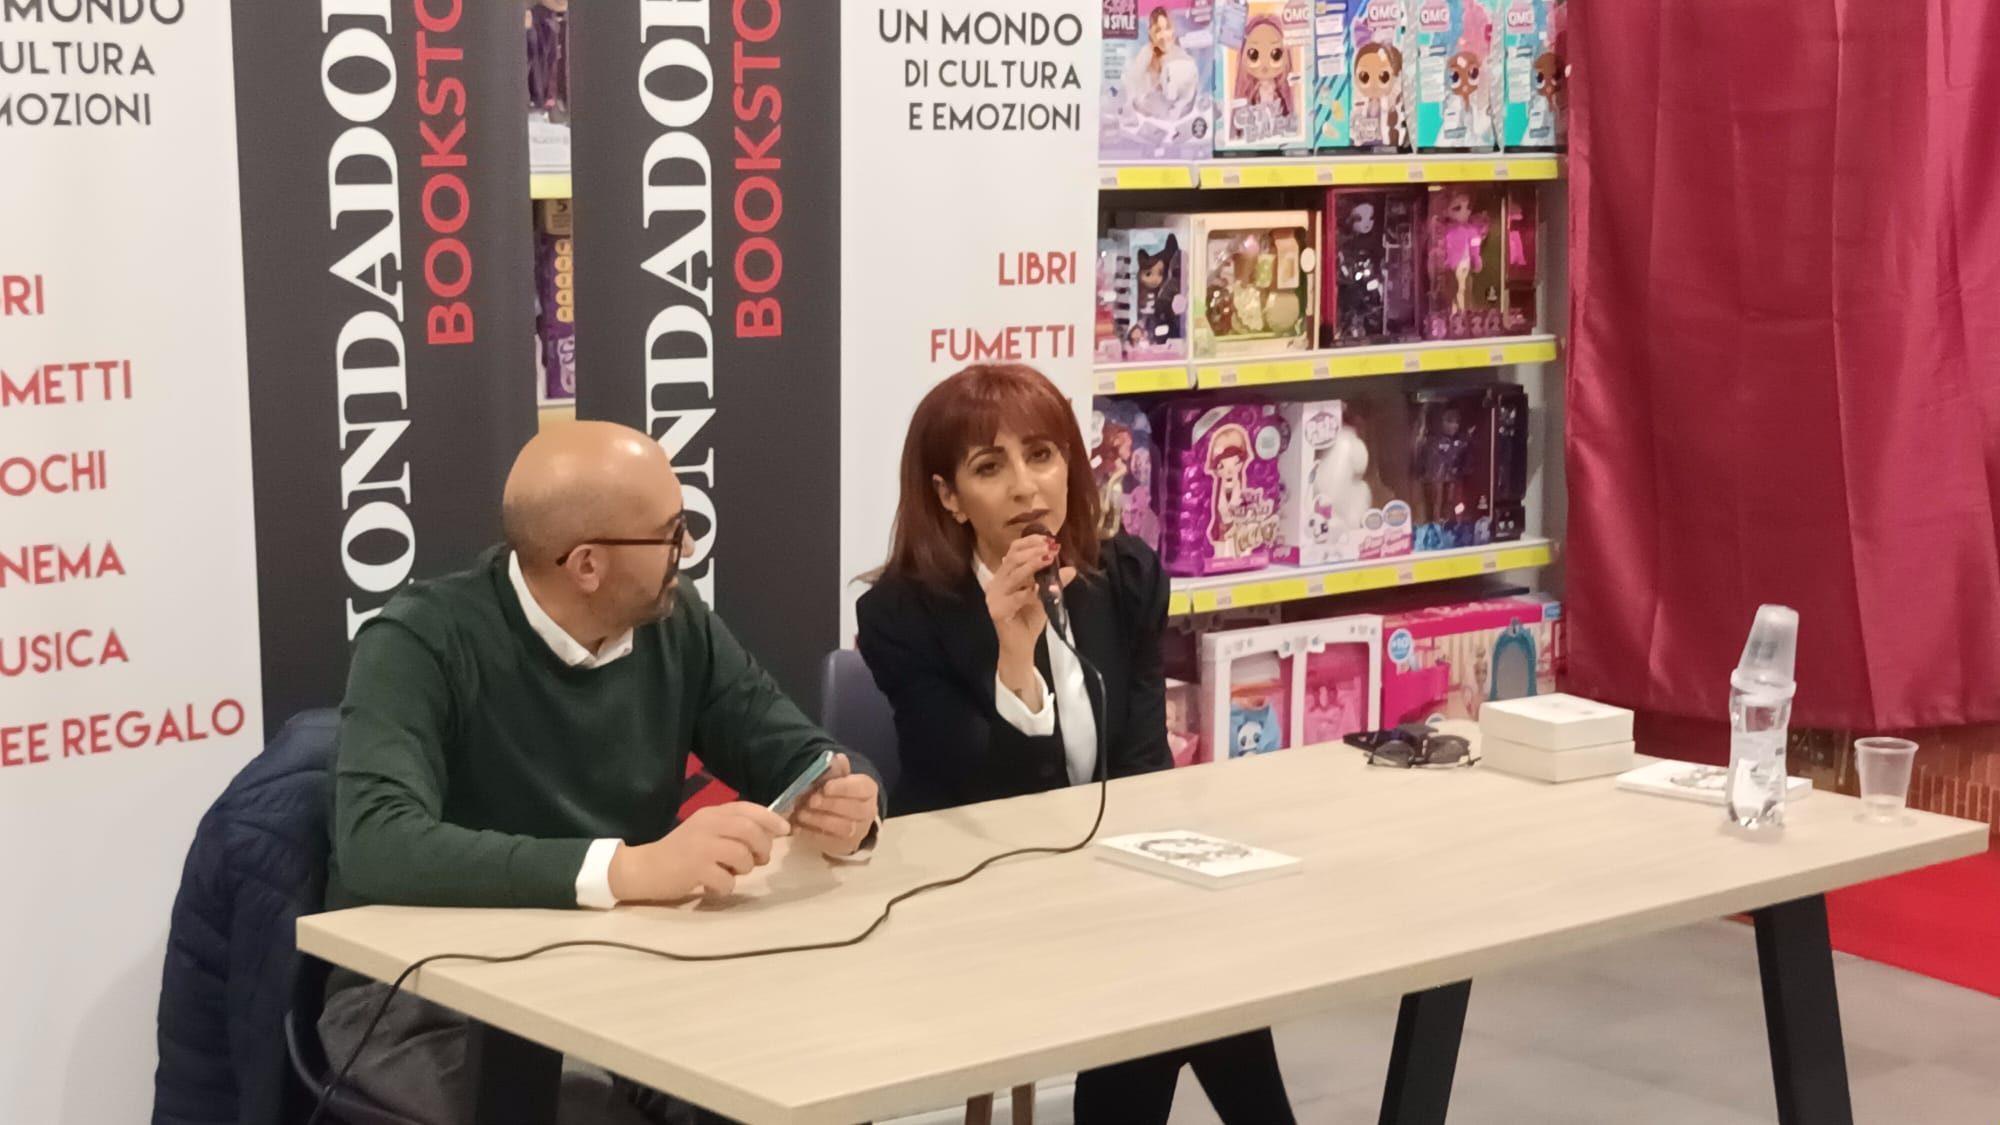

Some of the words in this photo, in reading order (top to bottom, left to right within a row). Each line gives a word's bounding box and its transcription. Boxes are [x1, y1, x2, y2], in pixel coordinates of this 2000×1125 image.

[3, 0, 185, 25] MONDO
[878, 8, 928, 44] UN
[941, 11, 1083, 46] MONDO
[904, 59, 929, 88] DI
[938, 59, 1082, 89] CULTURA
[909, 102, 923, 131] E
[932, 102, 1081, 131] EMOZIONI
[998, 251, 1077, 286] LIBRI
[930, 324, 1075, 362] FUMETTI
[61, 698, 245, 758] REGALO
